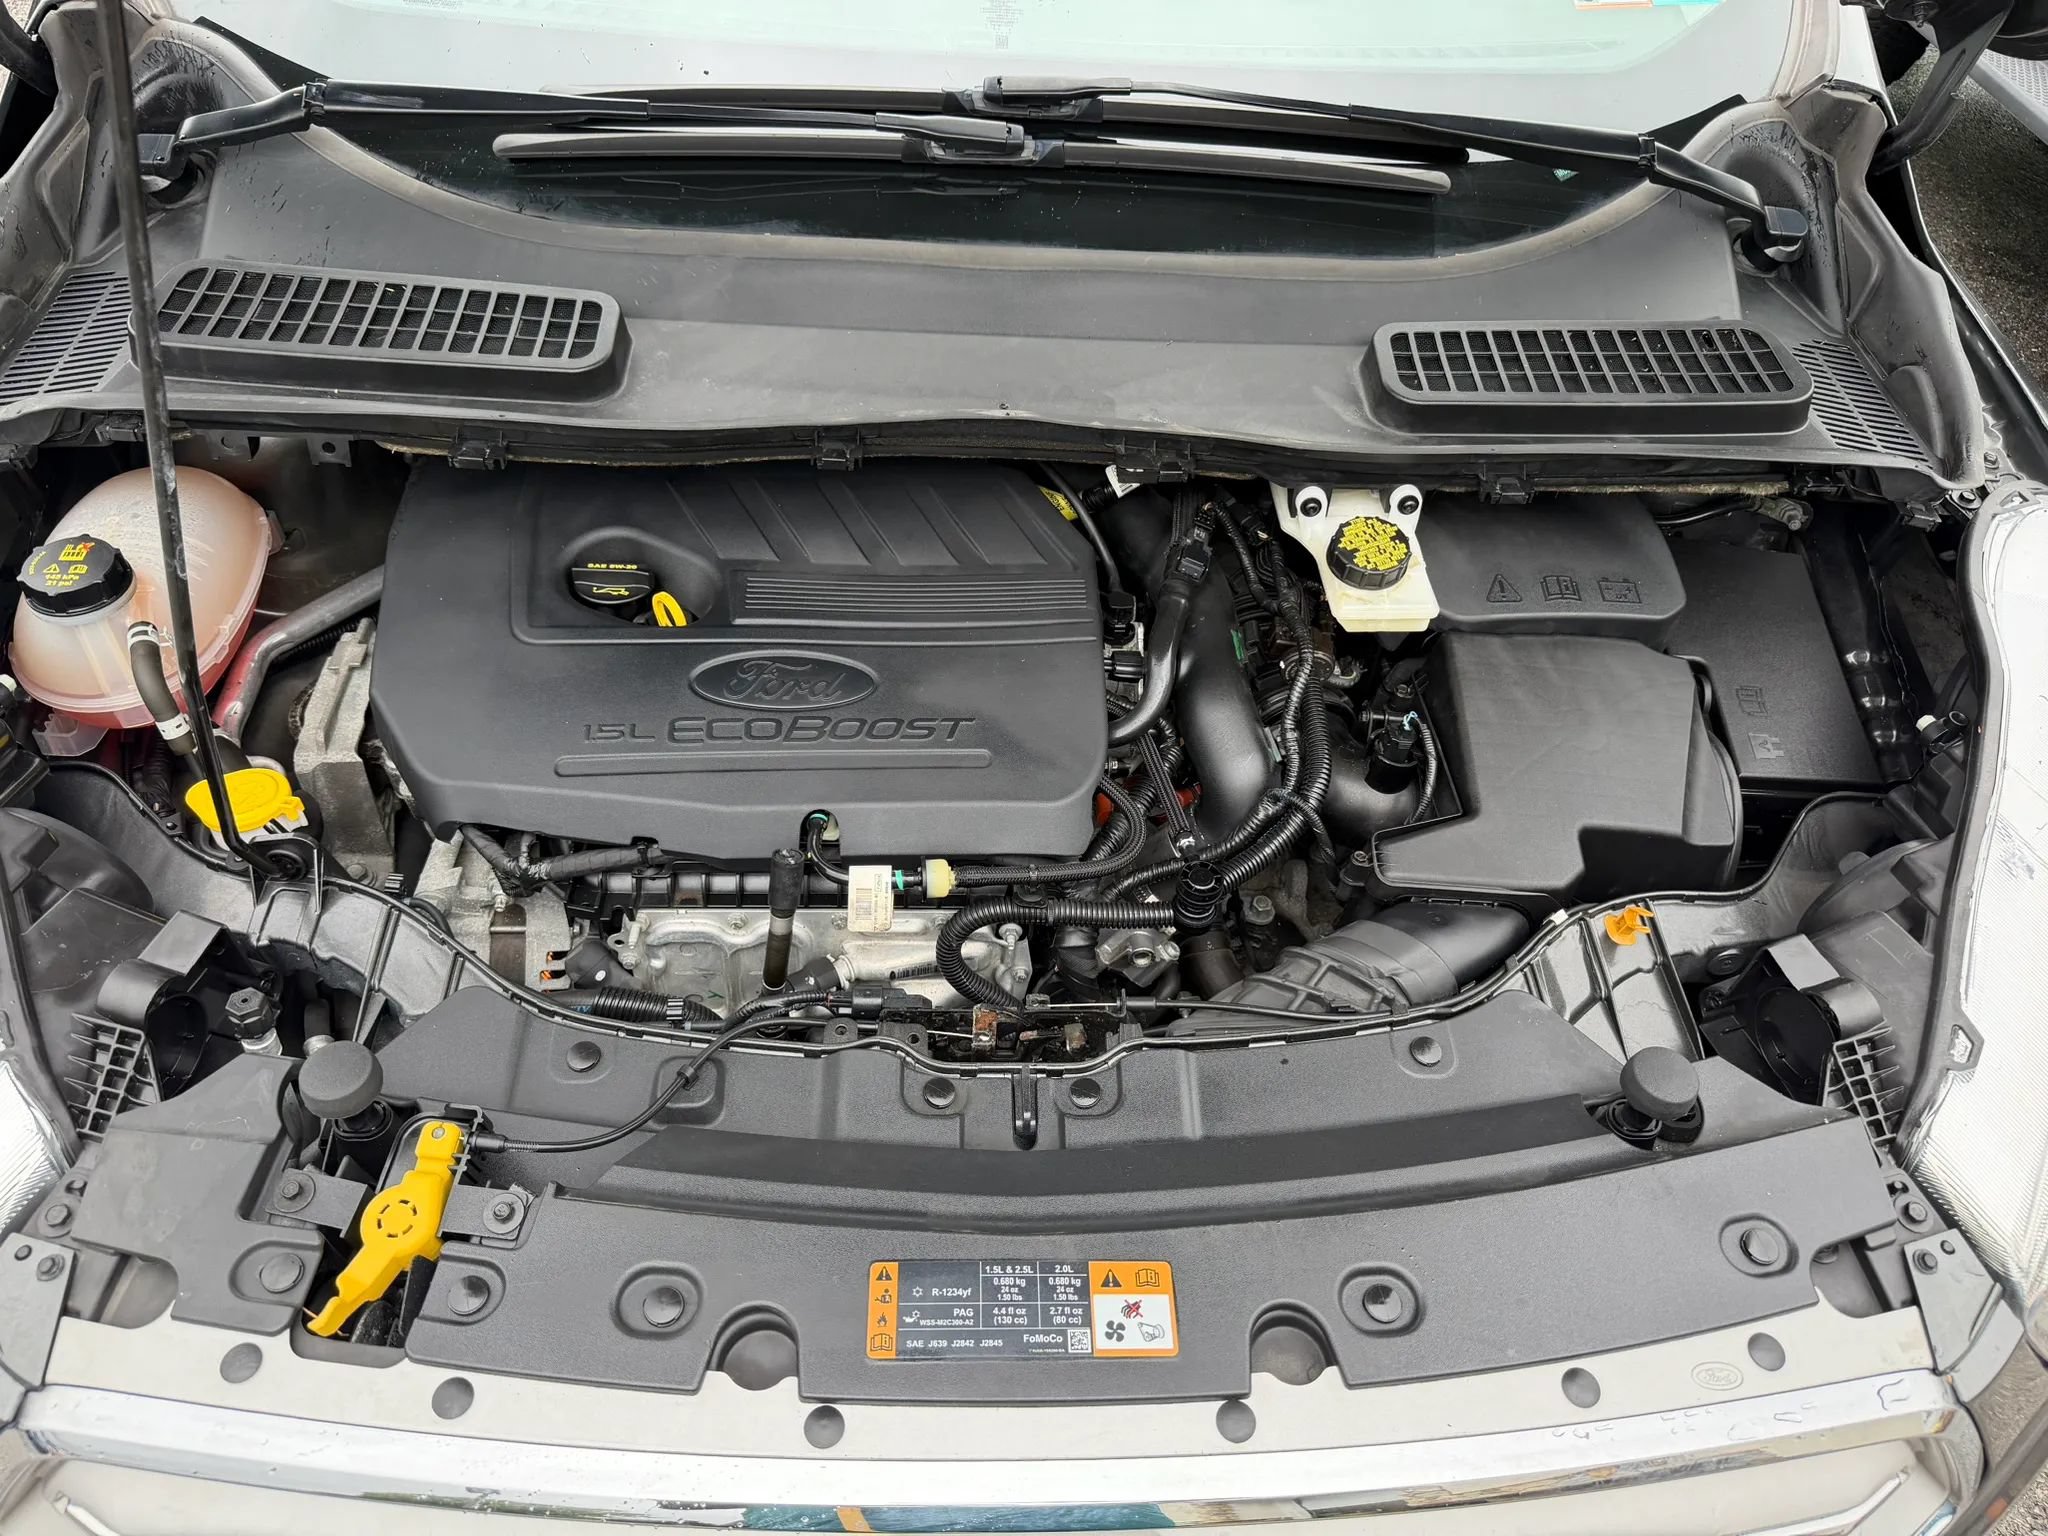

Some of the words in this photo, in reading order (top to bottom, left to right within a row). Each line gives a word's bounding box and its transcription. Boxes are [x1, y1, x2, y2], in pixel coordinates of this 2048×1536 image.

[723, 659, 847, 701] Ford
[583, 723, 657, 744] 1.5L
[985, 1265, 1004, 1274] 1.5L
[1006, 1266, 1013, 1274] &
[1015, 1265, 1034, 1274] 2.5L
[1054, 1264, 1074, 1273] 2.0L
[993, 1277, 1014, 1285] 0.680
[1015, 1277, 1026, 1287] kg
[1048, 1277, 1069, 1286] 0.680
[1070, 1277, 1081, 1287] kg
[931, 1287, 972, 1298] R-1234yf
[953, 1308, 974, 1317] PAG
[992, 1307, 1006, 1315] 4.4
[1008, 1306, 1014, 1315] fl
[1049, 1307, 1063, 1315] 2.7
[1064, 1307, 1070, 1315] fl
[993, 1316, 1012, 1326] (130
[1013, 1316, 1028, 1326] cc)
[1053, 1316, 1066, 1325] (80
[1068, 1316, 1082, 1325] cc)
[1023, 1334, 1063, 1343] FoMoCo
[906, 1340, 924, 1348] SAE
[928, 1340, 948, 1348] J639
[951, 1340, 975, 1348] J2842
[979, 1339, 1003, 1347] J2845
